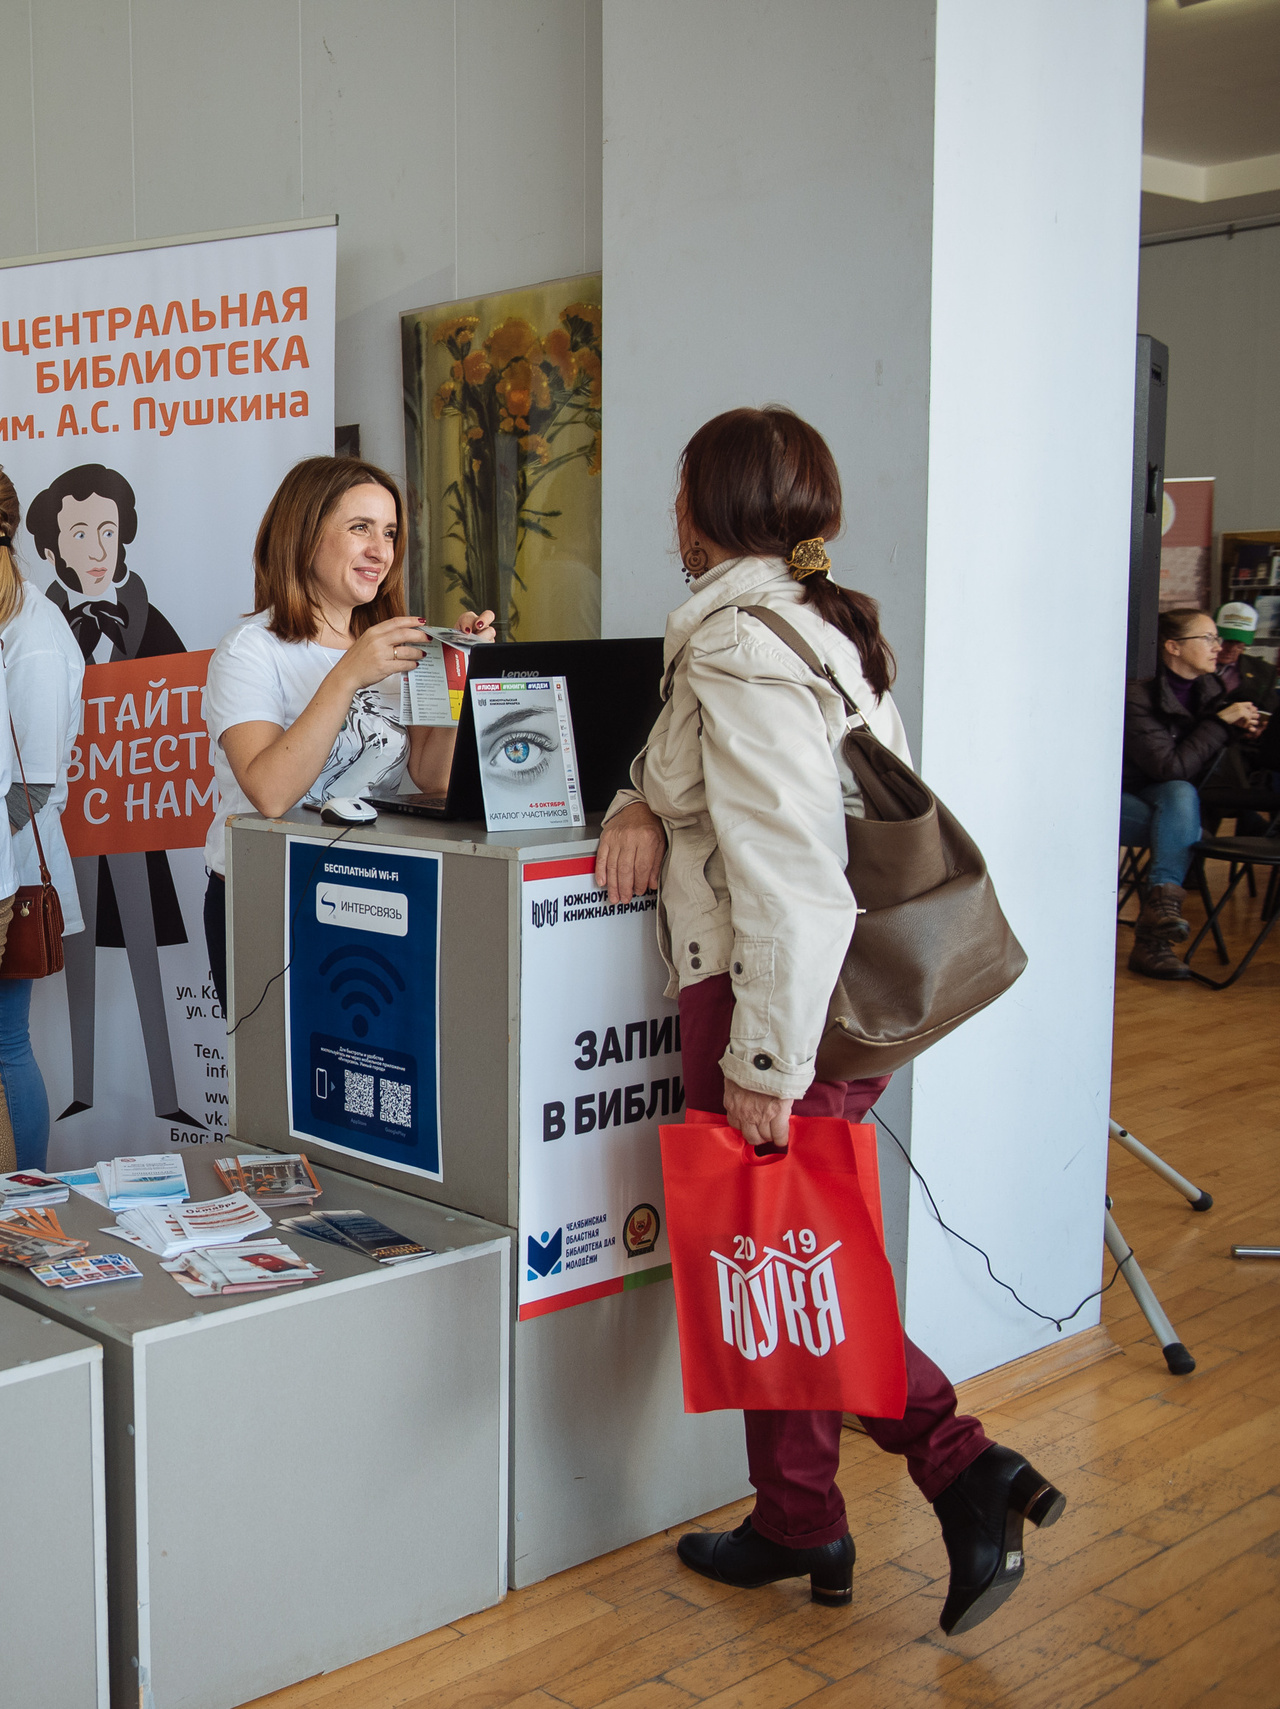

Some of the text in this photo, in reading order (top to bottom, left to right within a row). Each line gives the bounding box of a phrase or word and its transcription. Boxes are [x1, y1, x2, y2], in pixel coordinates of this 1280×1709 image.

[2, 286, 308, 356] ЦЕНТРАЛЬНАЯ
[36, 335, 310, 394] БИБЛИОТЕКА
[57, 401, 120, 437] А.С.
[133, 390, 309, 437] Пушкина
[501, 670, 540, 678] Lenovo
[77, 678, 206, 736] ТАЙТ
[83, 788, 111, 825] С
[489, 809, 568, 820] КАТАЛОГ УЧАСТНИКОВ
[324, 863, 399, 882] БЕСПЛАТНЫЙ Wi-Fi
[341, 901, 402, 920] ИНТЕРСВЯЗЬ
[563, 904, 615, 922] КНИЖНАЯ
[176, 987, 197, 1000] ул.
[186, 1006, 207, 1020] ул.
[194, 1043, 224, 1060] Тел.
[206, 1063, 229, 1078] inf
[543, 1101, 566, 1142] В
[170, 1128, 209, 1144] Блог:
[566, 1213, 607, 1232] ЧЕЛЯБИНСКАЯ
[566, 1228, 600, 1245] ОБЛАСТНАЯ
[733, 1228, 817, 1262] 20 19
[565, 1236, 616, 1258] БИБЛИОТЕКА ДЛЯ
[565, 1254, 598, 1270] МОЛОДЁЖИ
